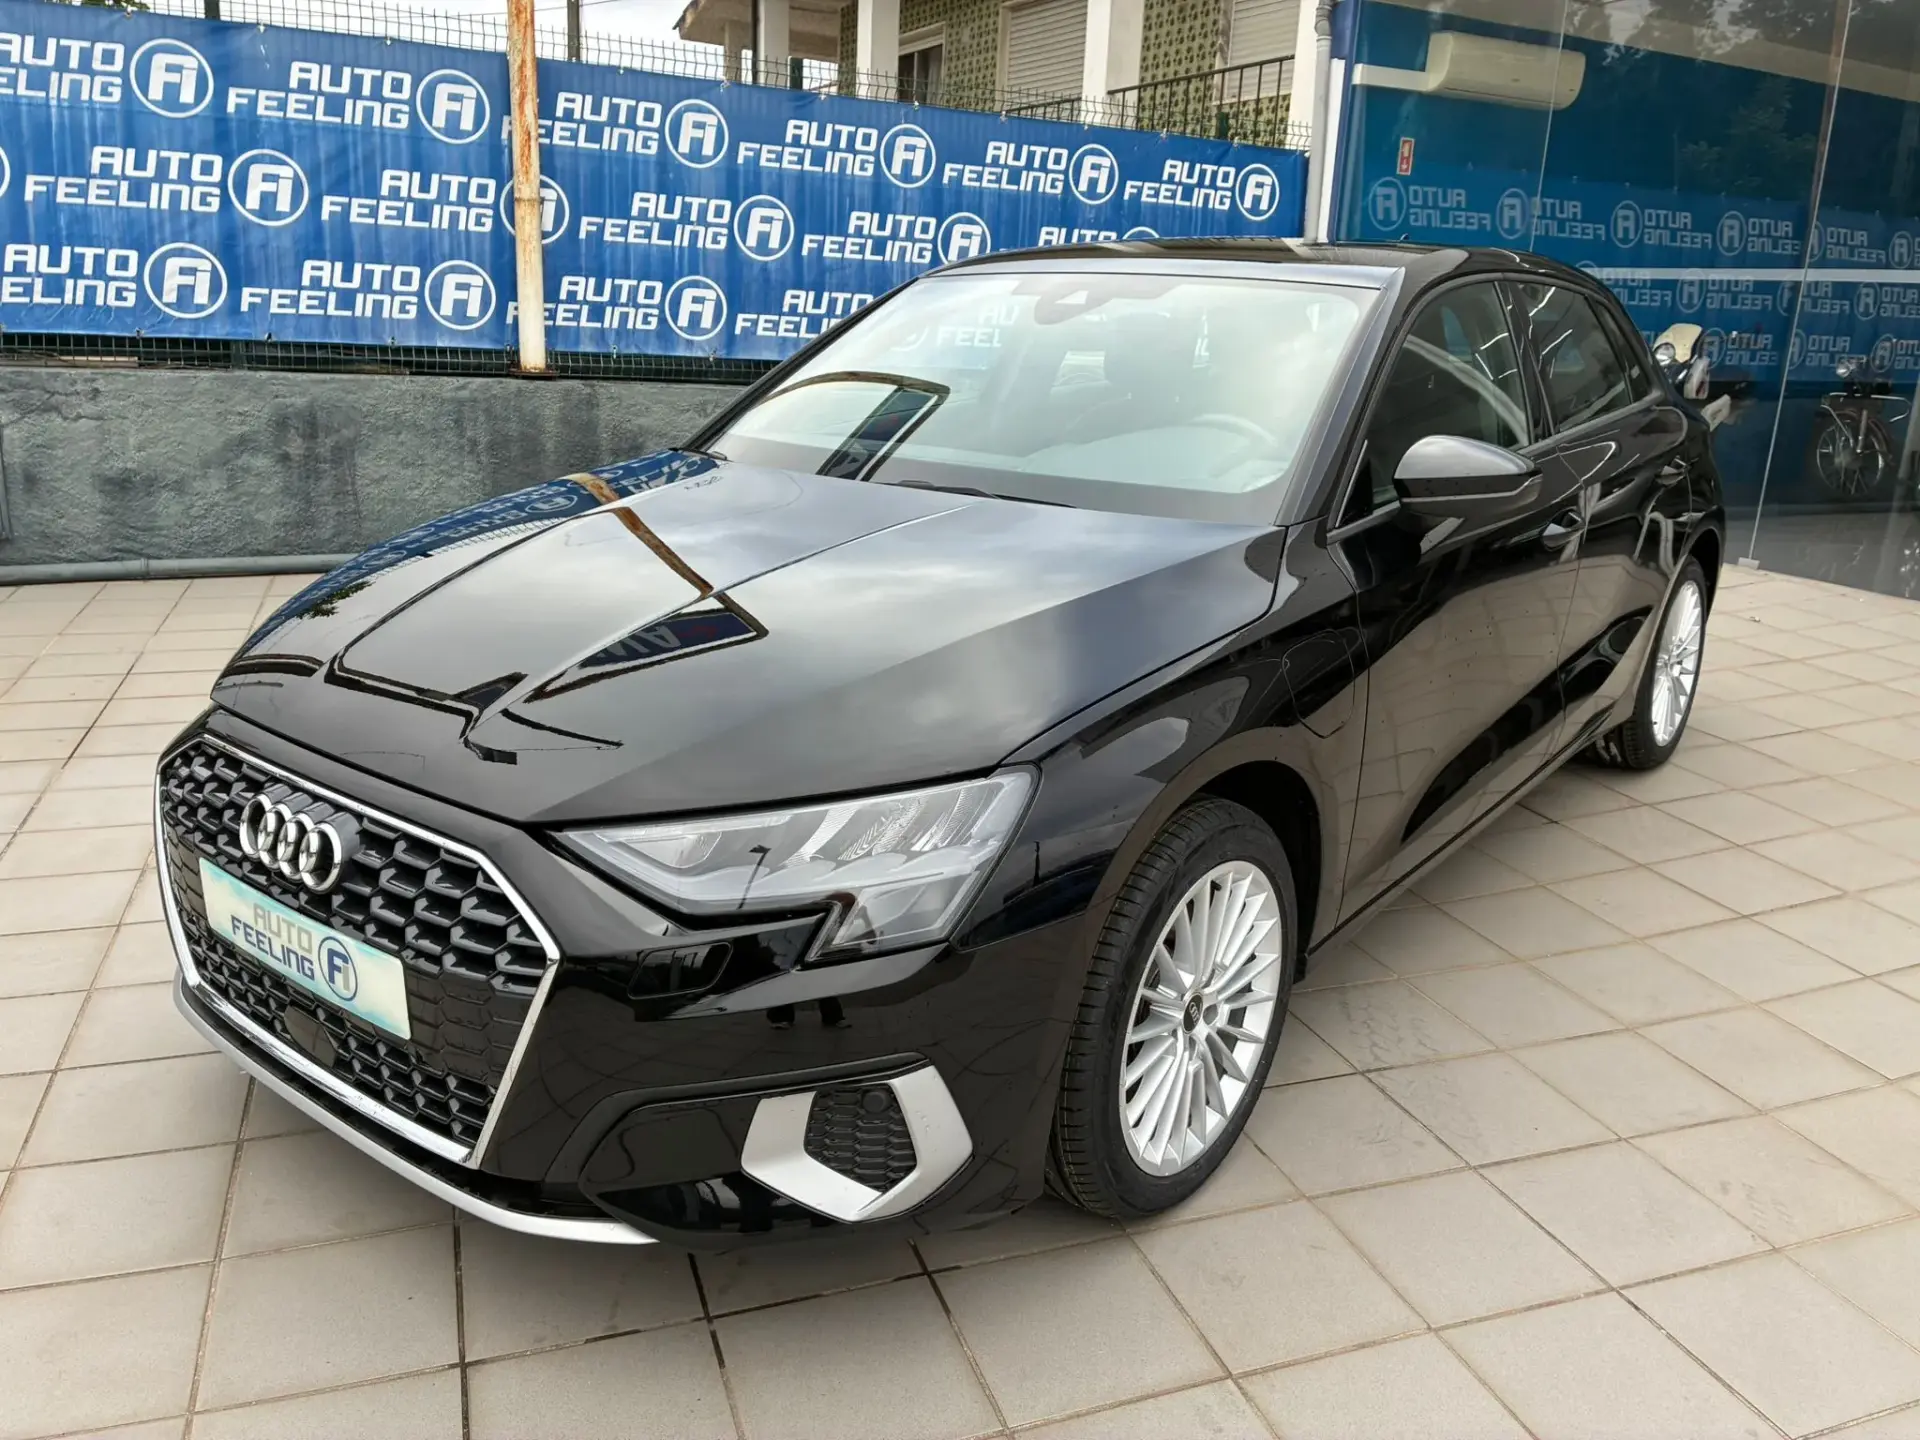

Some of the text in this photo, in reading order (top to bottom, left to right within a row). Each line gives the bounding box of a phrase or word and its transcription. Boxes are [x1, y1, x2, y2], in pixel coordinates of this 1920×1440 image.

[290, 62, 412, 100] AUTO
[227, 87, 409, 129] FEELING
[556, 92, 663, 128] AUTO
[786, 120, 878, 151] AUTO
[91, 146, 223, 182] AUTO
[738, 142, 875, 177] FEELING
[986, 142, 1069, 170] AUTO
[381, 170, 497, 204] AUTO
[943, 163, 1065, 194] FEELING
[1163, 160, 1236, 188] AUTO
[25, 175, 221, 213] FEELING
[632, 192, 732, 223] AUTO
[1124, 181, 1232, 211] FEELING
[322, 196, 494, 233] FEELING
[848, 212, 937, 239] AUTO
[580, 216, 728, 250] FEELING
[802, 234, 933, 264] FEELING
[4, 244, 138, 277] AUTO
[302, 260, 421, 292] AUTO
[1, 277, 137, 307] ELING
[241, 287, 418, 320] FEELING
[560, 276, 663, 305] AUTO
[253, 903, 313, 955] AUTO
[231, 915, 315, 982] FEELING
